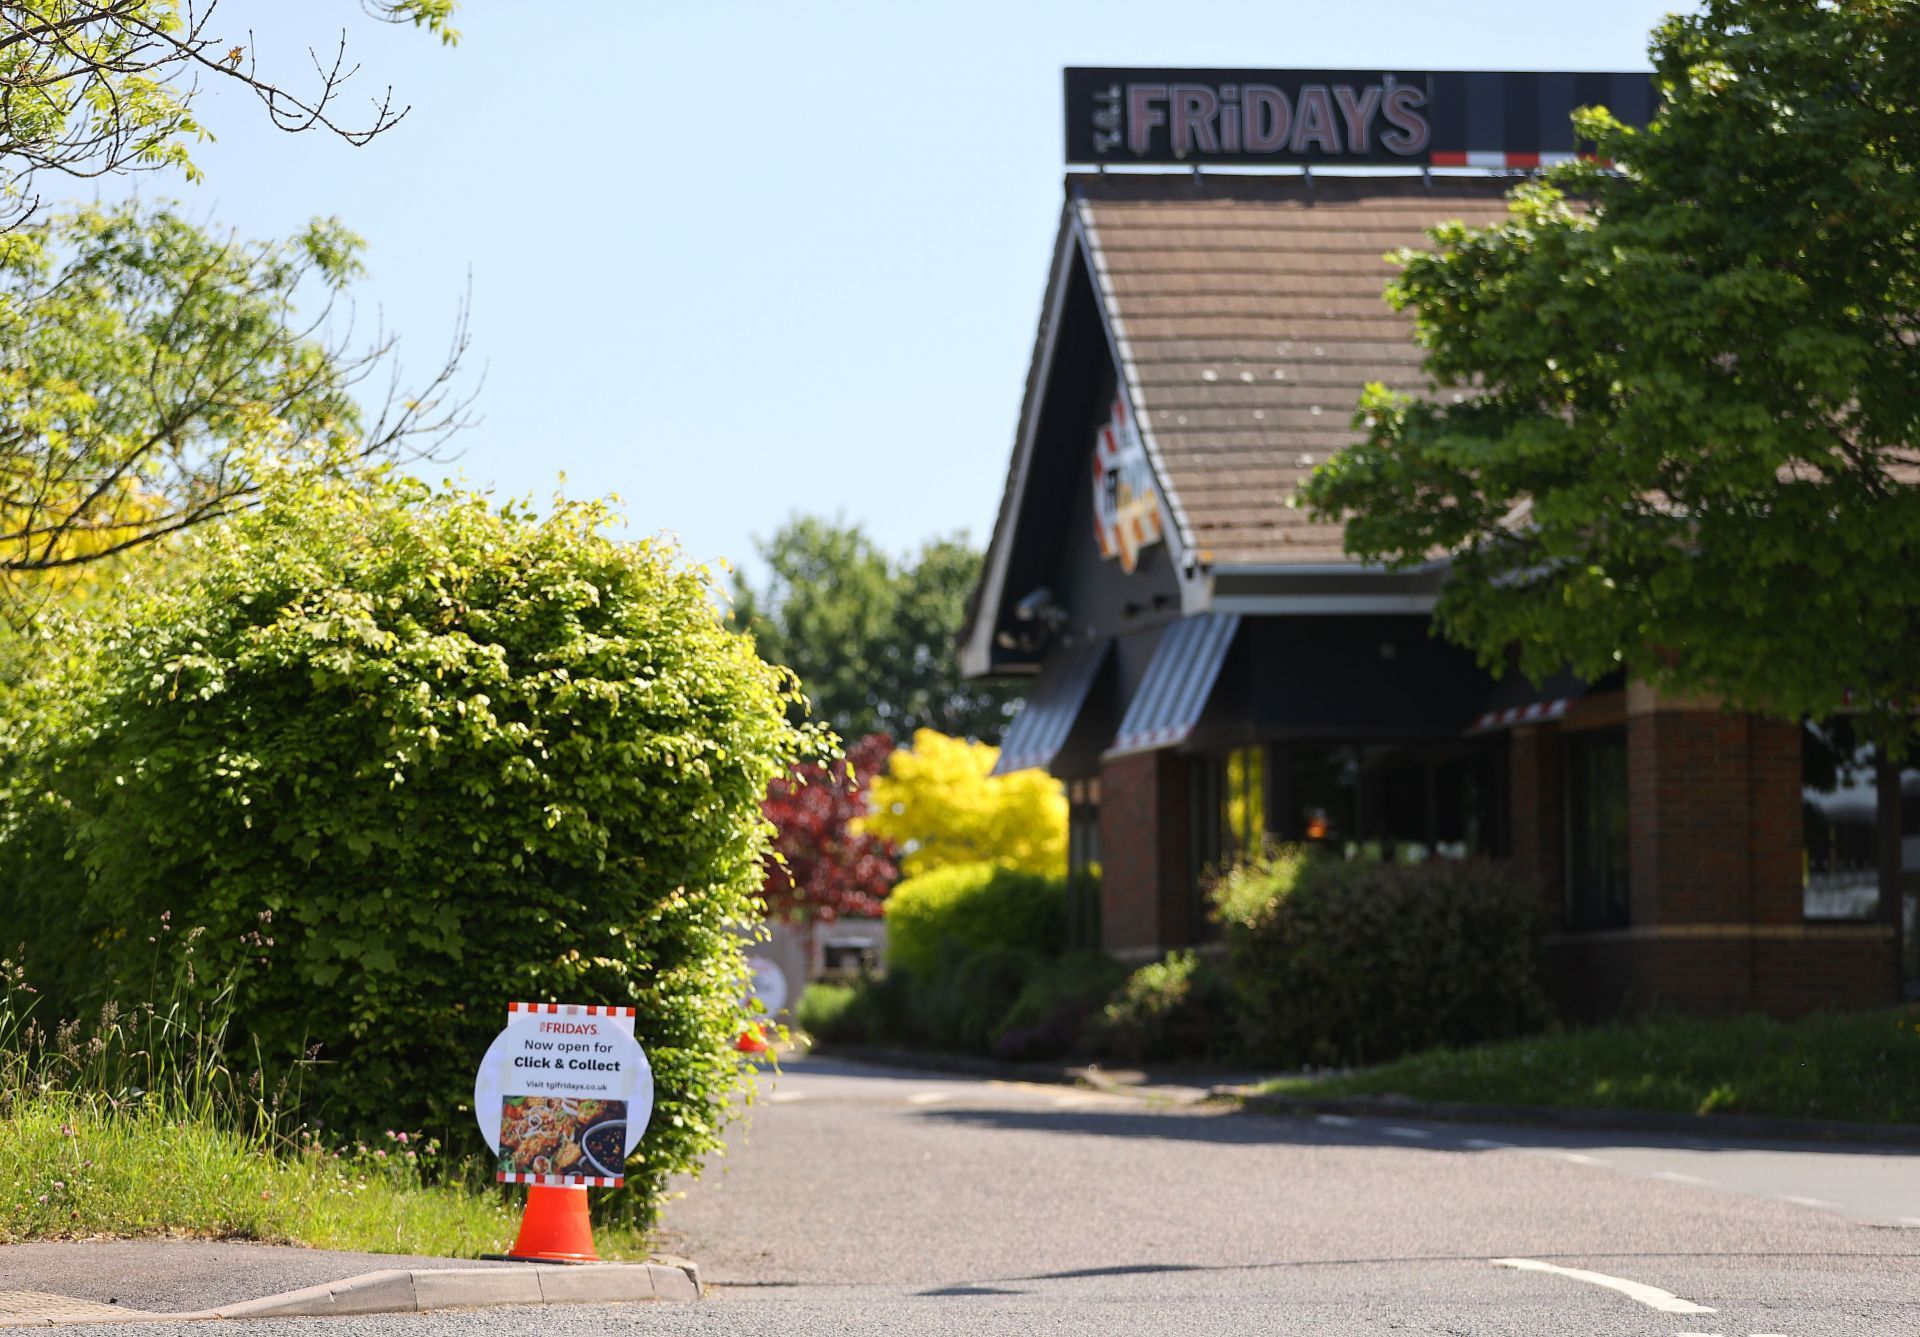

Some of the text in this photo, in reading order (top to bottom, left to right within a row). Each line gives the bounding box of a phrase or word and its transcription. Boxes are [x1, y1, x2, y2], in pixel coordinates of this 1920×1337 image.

[524, 1039, 614, 1054] Now open for
[514, 1056, 621, 1072] Click & Collect
[526, 1080, 608, 1092] Visit tgifridays.co.uk
